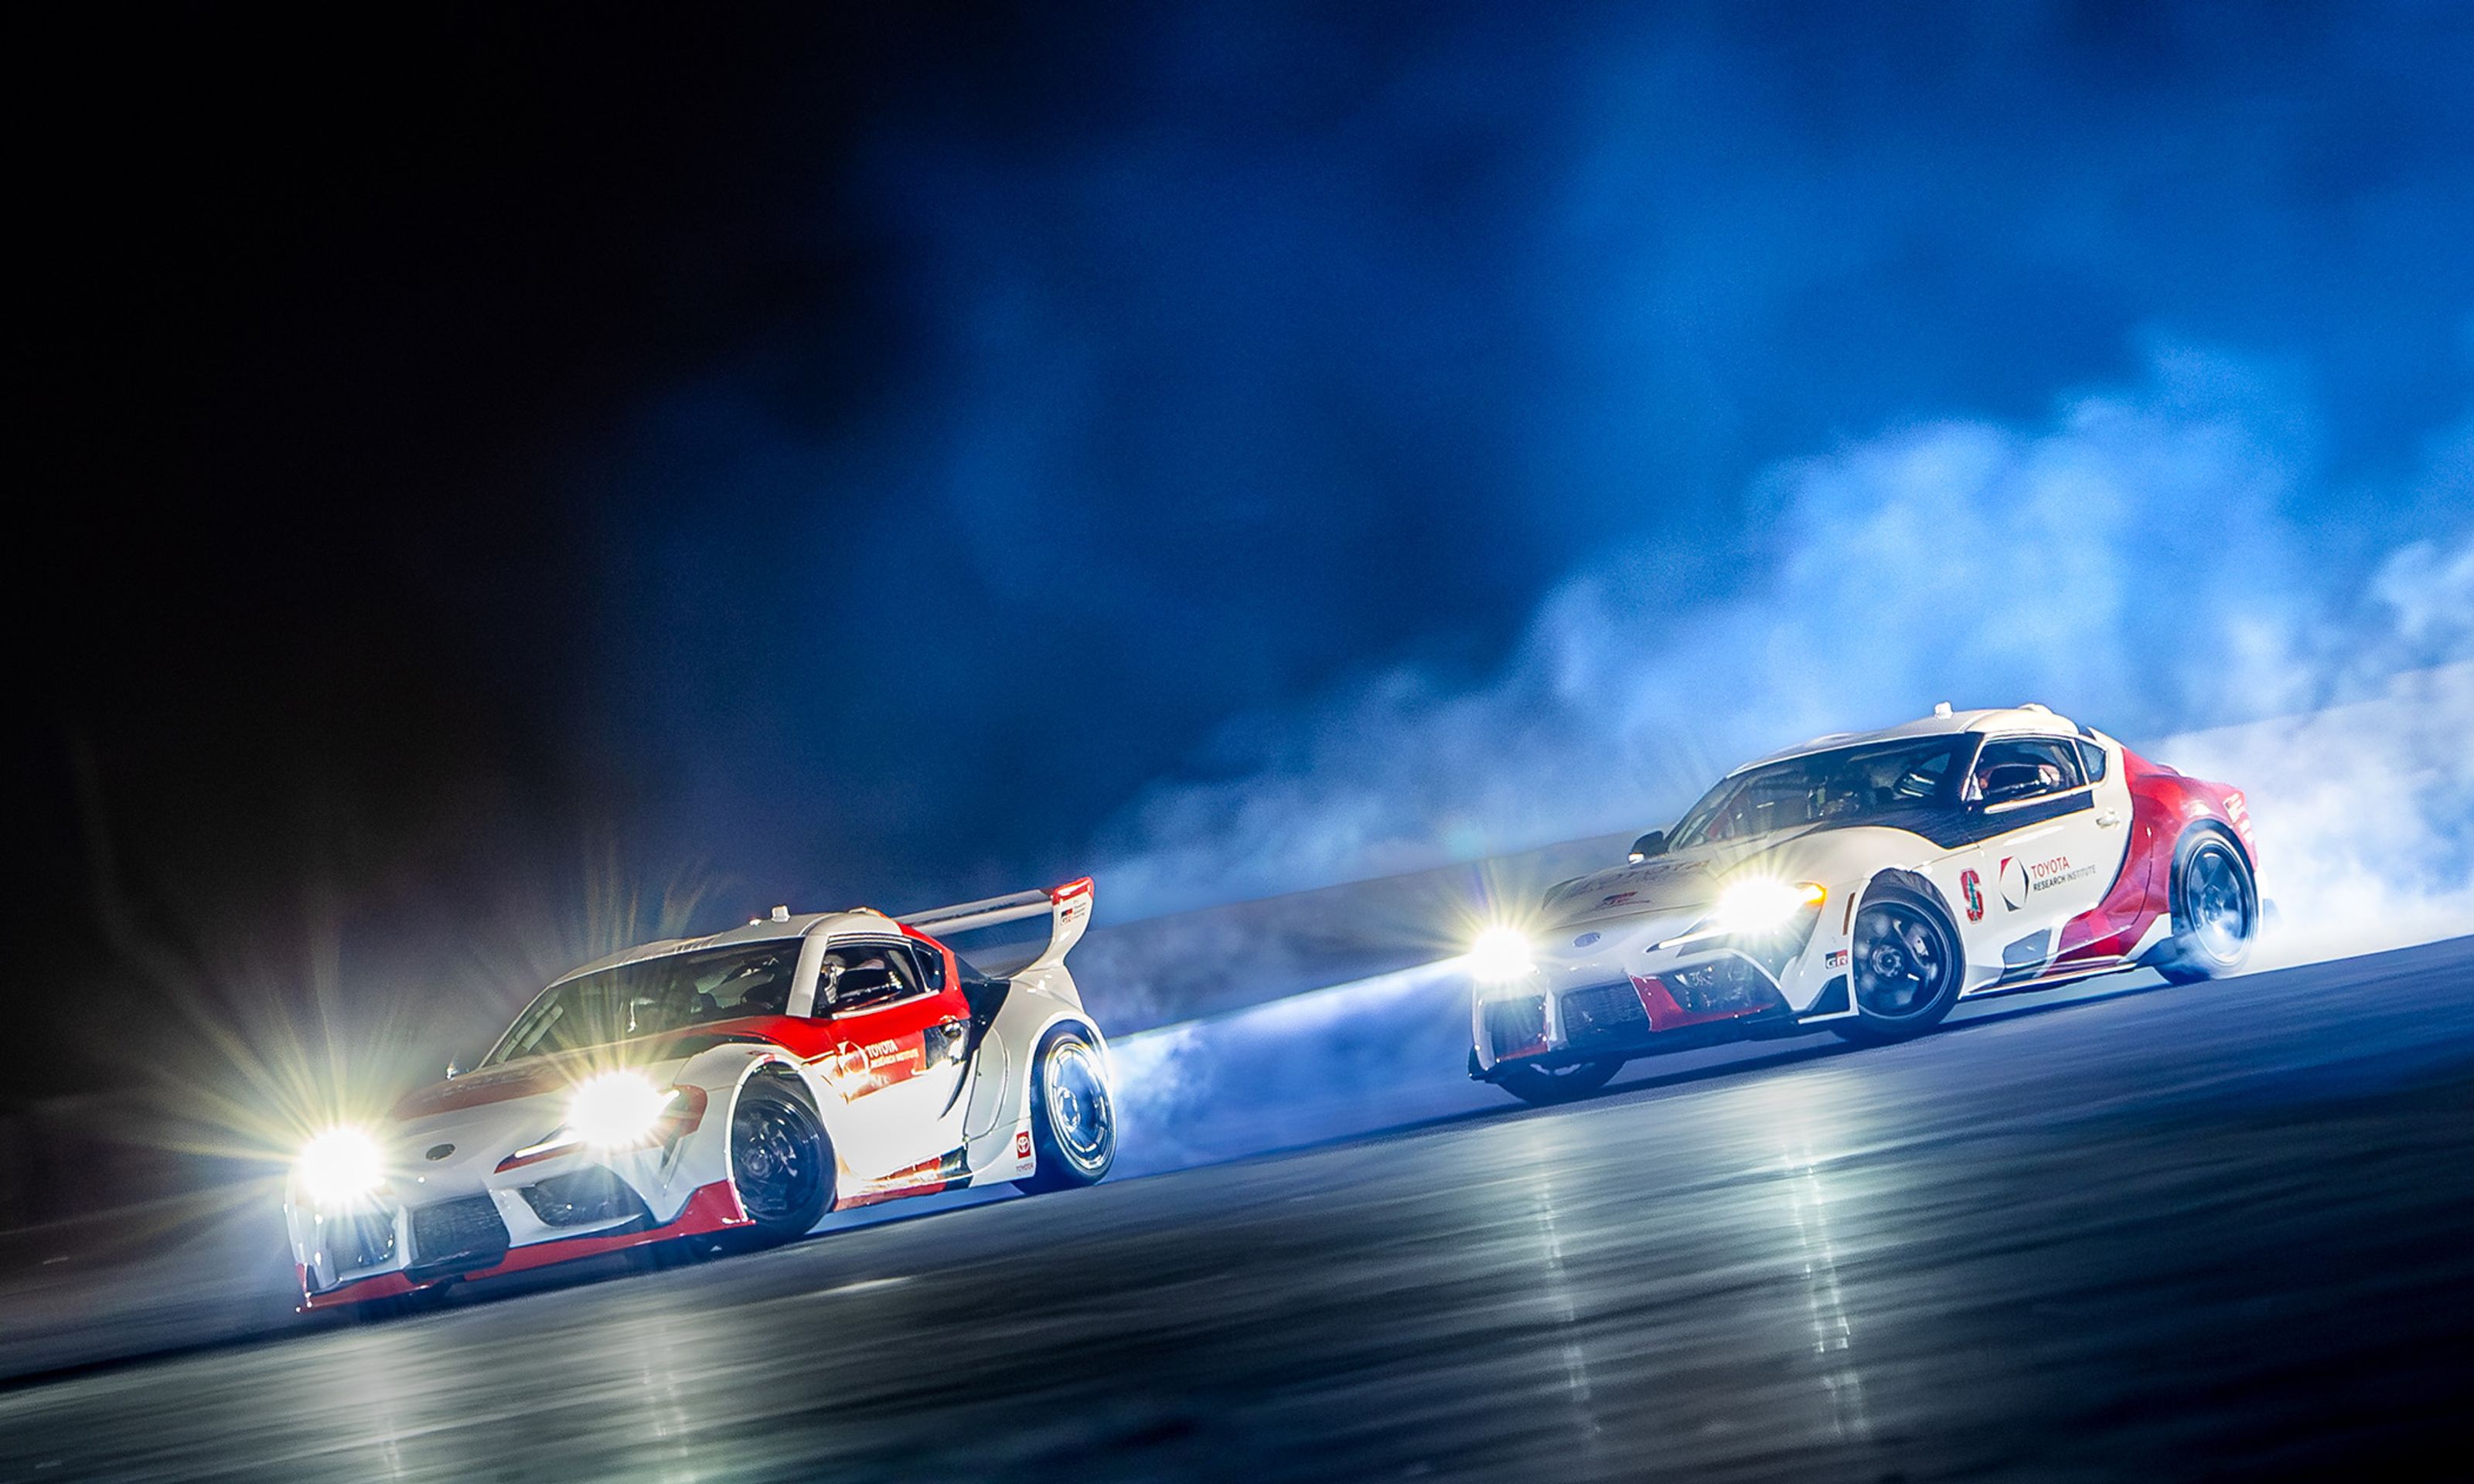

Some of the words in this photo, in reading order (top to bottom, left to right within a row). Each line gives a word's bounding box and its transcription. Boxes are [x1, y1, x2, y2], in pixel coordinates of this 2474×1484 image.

[2031, 856, 2070, 879] TOYOTA
[2033, 876, 2066, 891] RESEARCH
[2067, 865, 2096, 883] INSTITUTE
[1826, 955, 1848, 969] GR
[864, 1039, 898, 1058] TOYOTA
